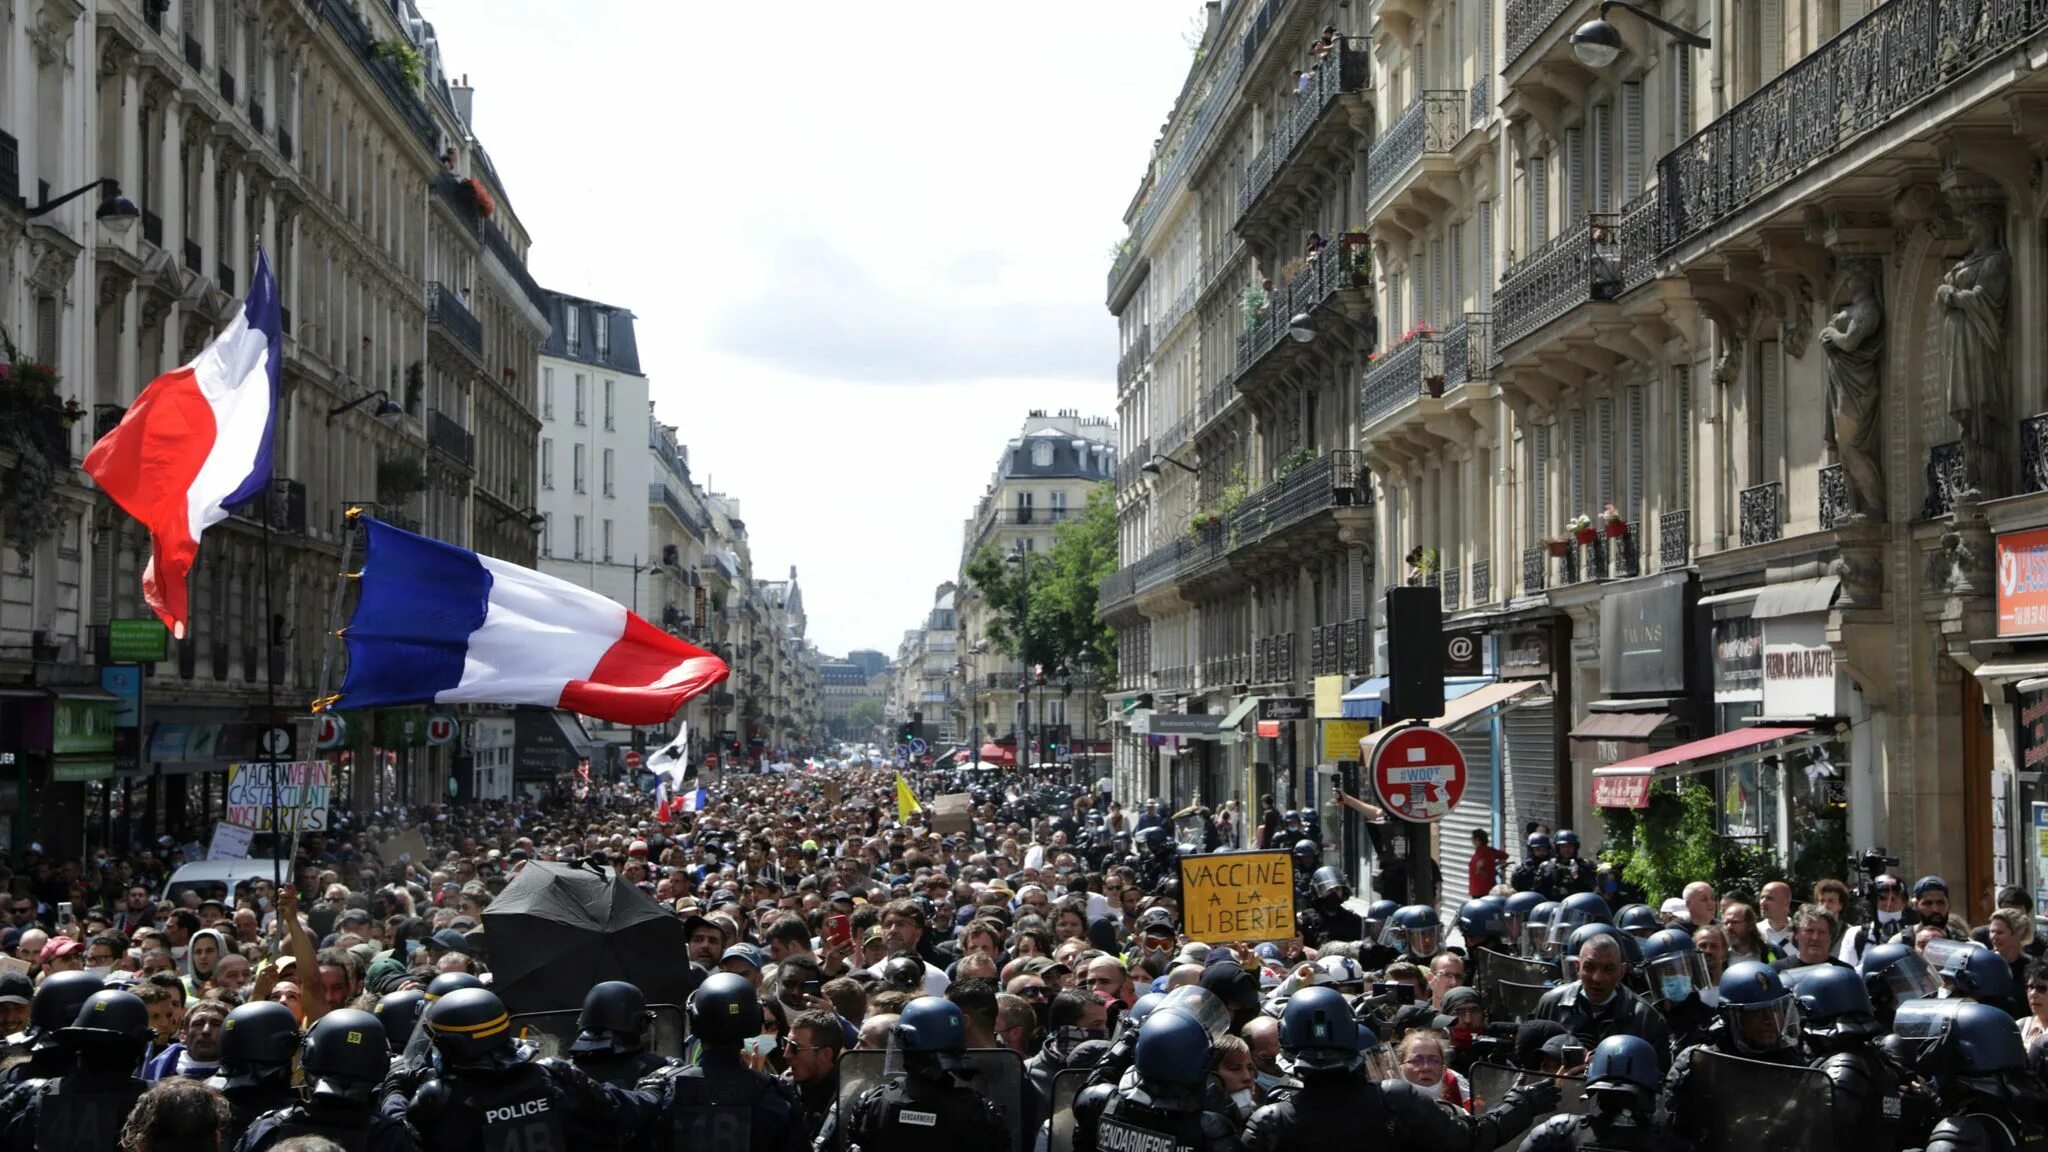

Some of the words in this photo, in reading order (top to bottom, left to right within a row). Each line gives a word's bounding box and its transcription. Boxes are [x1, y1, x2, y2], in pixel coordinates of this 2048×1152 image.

[2016, 546, 2048, 593] L'ASS
[1623, 624, 1662, 643] TWINS
[1448, 637, 1473, 662] @
[431, 721, 449, 739] U
[1184, 856, 1286, 888] VACCINÉ
[1208, 892, 1222, 907] A
[1236, 890, 1262, 905] LA
[1191, 898, 1289, 935] LIBERTÉ
[486, 1098, 550, 1124] POLICE
